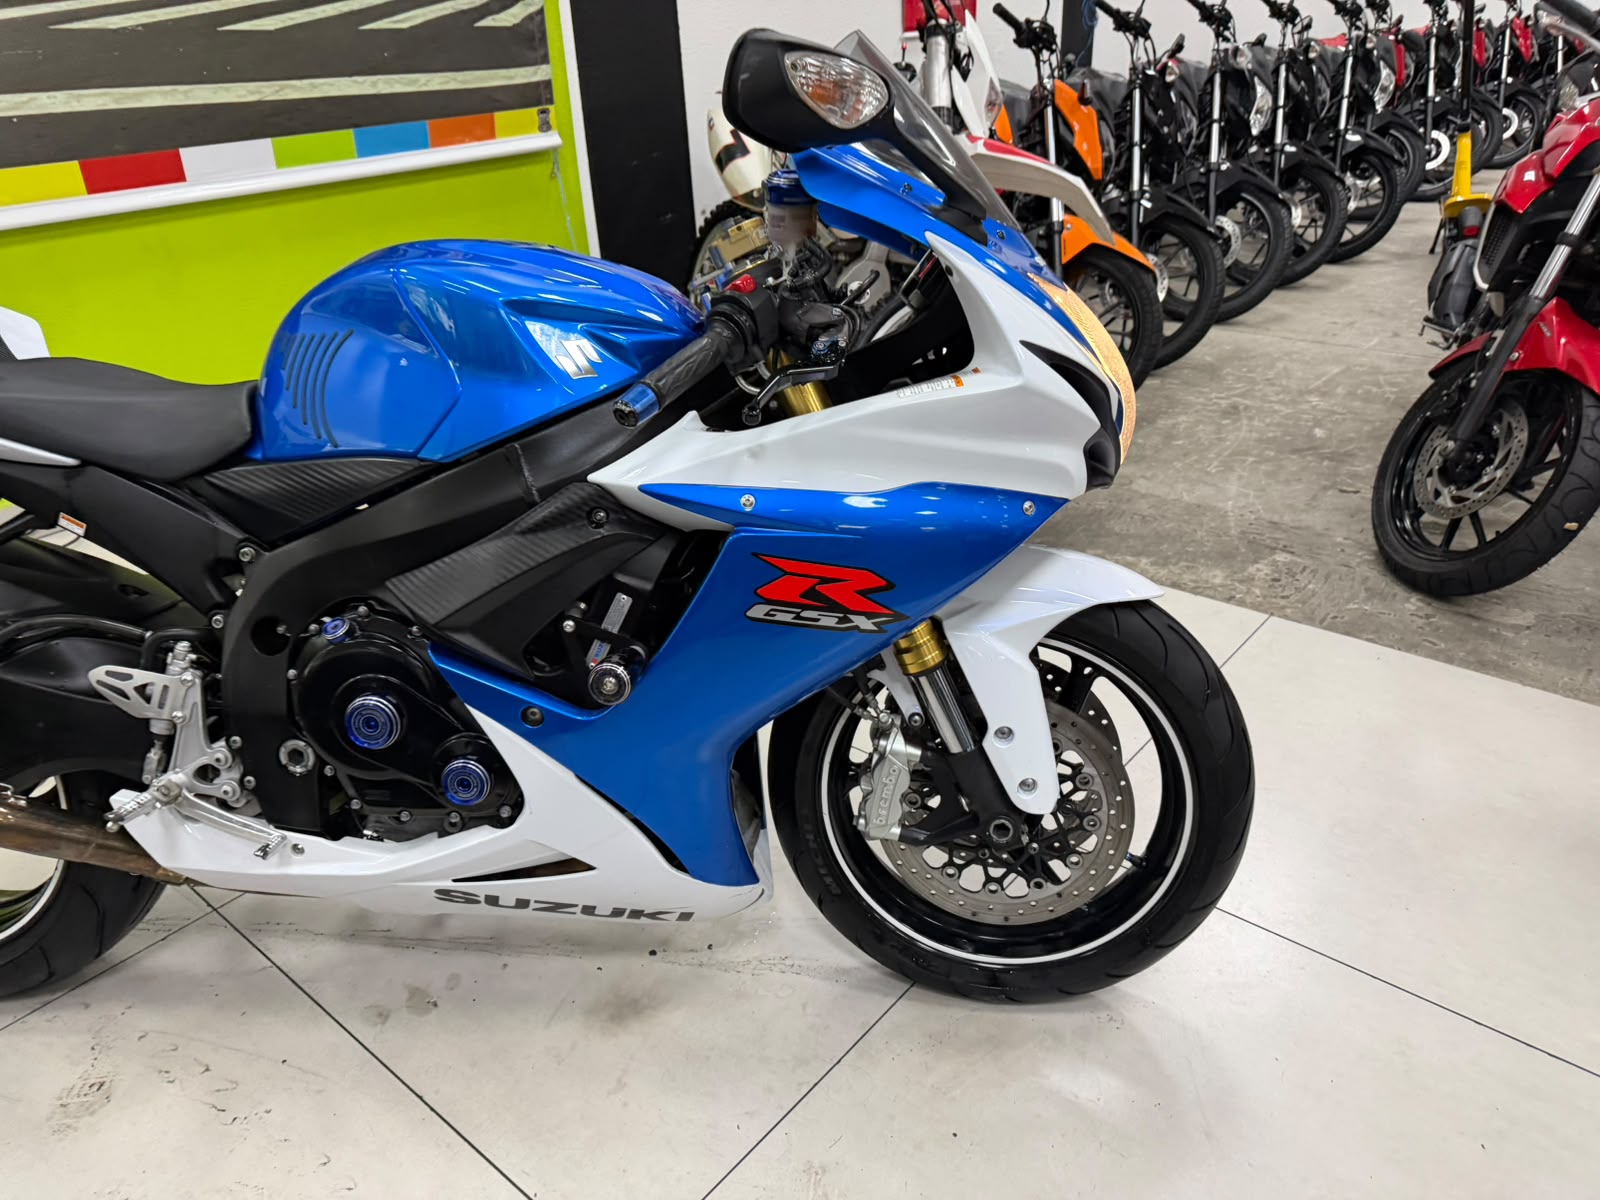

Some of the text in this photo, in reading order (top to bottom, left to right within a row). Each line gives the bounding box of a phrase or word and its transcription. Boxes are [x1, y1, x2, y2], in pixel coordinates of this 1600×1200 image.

[754, 553, 896, 615] R
[746, 603, 895, 631] GSX
[871, 764, 898, 826] brembo
[434, 888, 695, 922] SUZUKI
